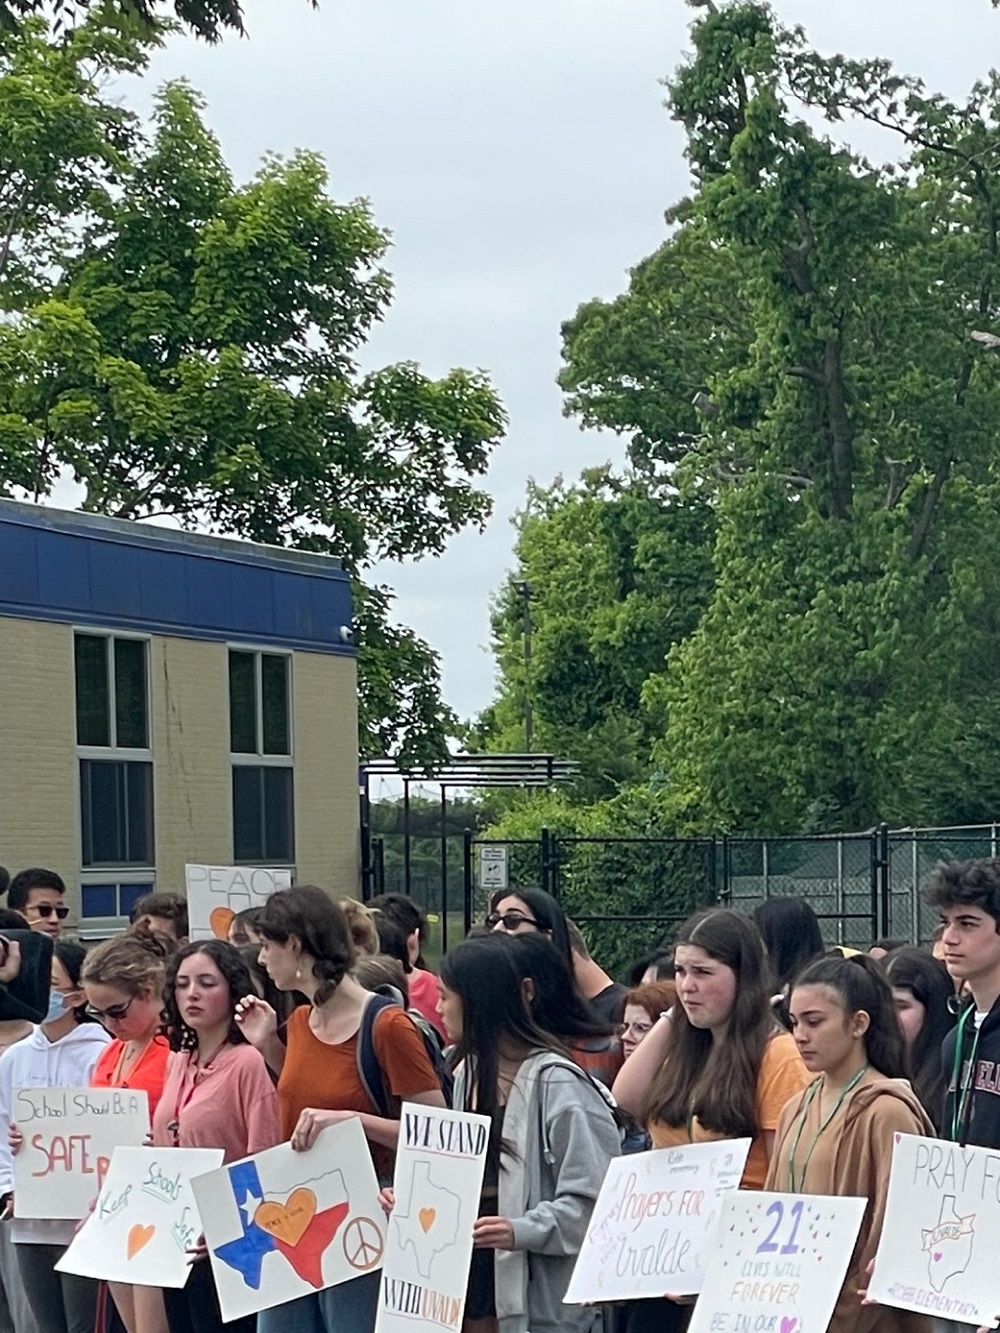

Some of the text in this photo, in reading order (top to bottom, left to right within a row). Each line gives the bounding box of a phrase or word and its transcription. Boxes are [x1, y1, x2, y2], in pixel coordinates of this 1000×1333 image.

[17, 1089, 67, 1123] School
[129, 1096, 139, 1114] A
[405, 1113, 486, 1156] WE STAND
[32, 1134, 94, 1177] SAFE
[914, 1144, 976, 1193] PRAY
[756, 1200, 804, 1255] 21
[774, 1261, 803, 1278] WILL
[384, 1276, 422, 1315] WITH
[730, 1281, 799, 1305] FOREVER
[710, 1312, 730, 1332] BE
[733, 1313, 752, 1333] IN
[754, 1313, 779, 1332] OUR
